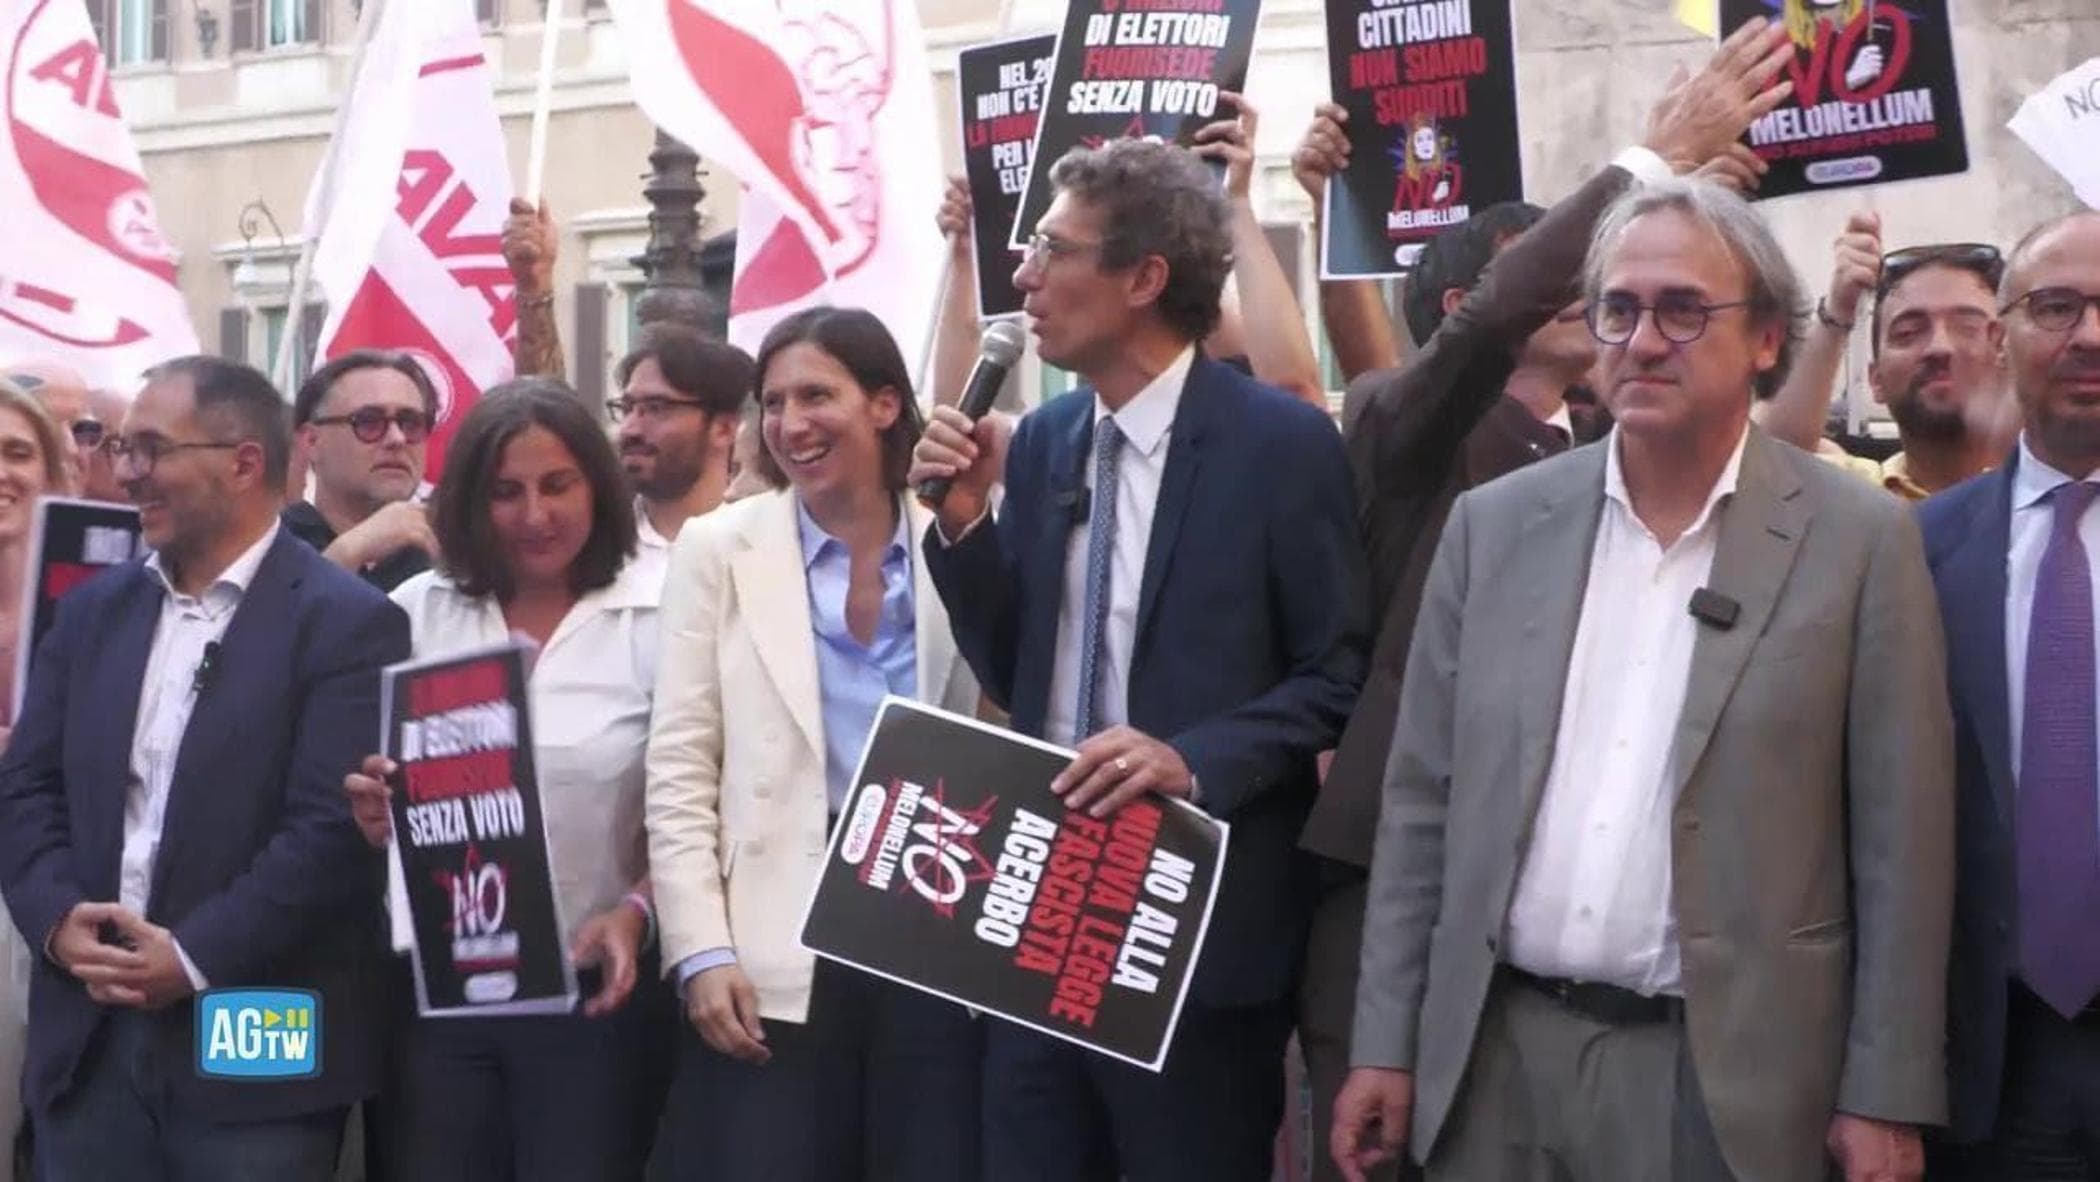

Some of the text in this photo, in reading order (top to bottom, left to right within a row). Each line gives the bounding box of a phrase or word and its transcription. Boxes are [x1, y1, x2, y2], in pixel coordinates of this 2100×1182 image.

[1084, 12, 1231, 48] DI ELETTORI
[1357, 0, 1472, 49] CITTADINI
[999, 61, 1027, 91] NEL
[1350, 36, 1487, 89] NON SIAMO
[976, 90, 1011, 121] NON
[1066, 80, 1218, 118] SENZA VOTO
[1750, 88, 1936, 147] MELONELLUM
[991, 140, 1024, 171] PER
[406, 786, 526, 847] SENZA VOTO
[867, 780, 925, 891] MELONELLUM
[902, 795, 980, 904] NO
[974, 807, 1059, 949] ACERBO
[453, 862, 507, 940] NO
[1014, 811, 1108, 975] FASCISTA
[1050, 802, 1163, 1028] NUOVA LEGGE
[1111, 848, 1196, 994] NO ALLA
